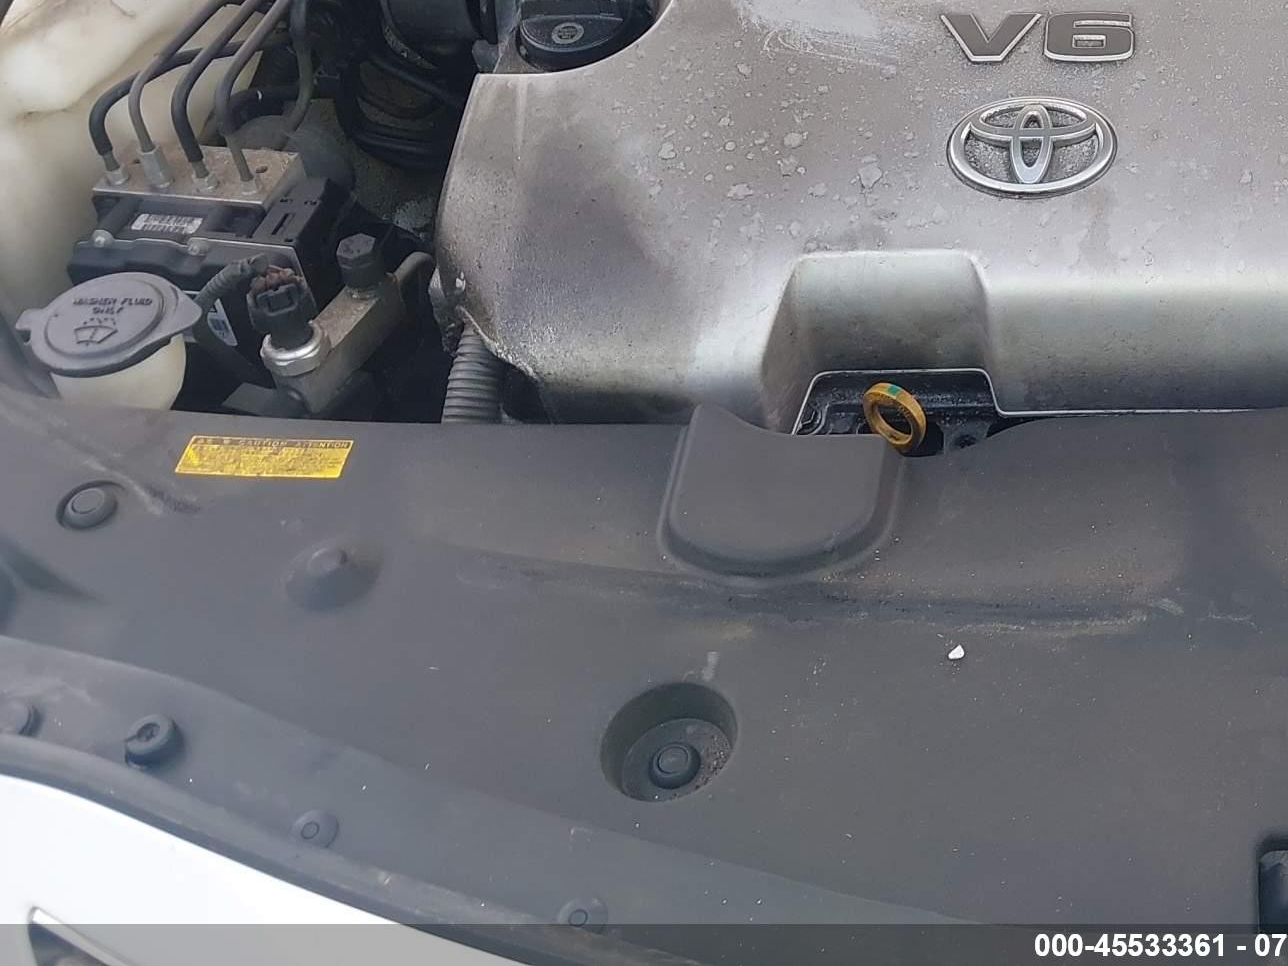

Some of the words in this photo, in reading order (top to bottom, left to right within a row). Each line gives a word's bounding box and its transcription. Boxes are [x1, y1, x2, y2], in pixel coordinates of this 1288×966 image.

[940, 12, 1136, 63] V6
[73, 297, 118, 306] WASHER
[120, 297, 153, 306] FLUID
[238, 439, 288, 448] CAUTION
